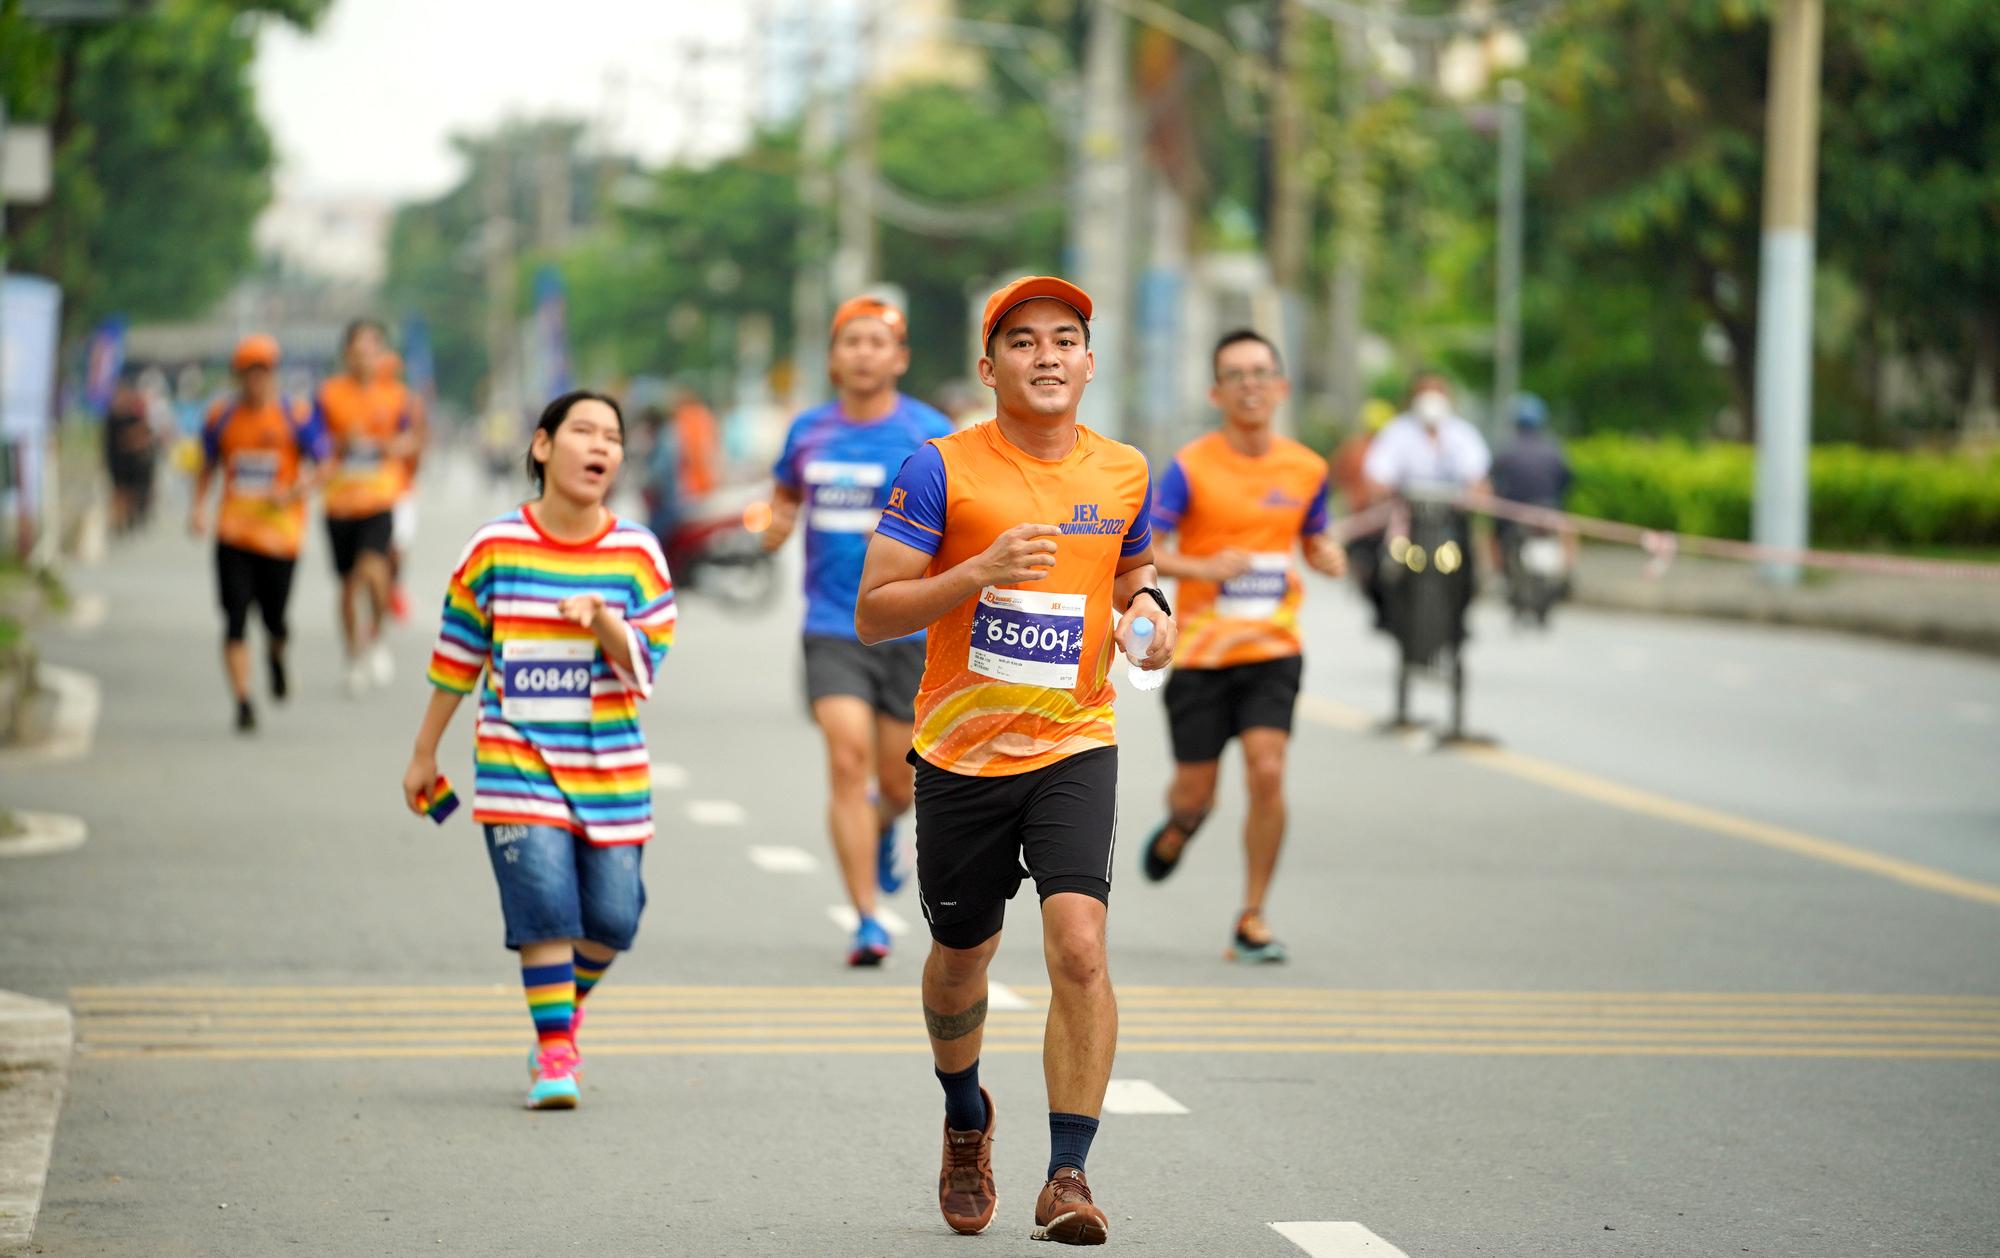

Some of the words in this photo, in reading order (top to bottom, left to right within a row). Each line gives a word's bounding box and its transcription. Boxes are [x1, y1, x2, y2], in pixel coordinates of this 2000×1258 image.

[1072, 503, 1099, 522] JEX
[1059, 522, 1098, 535] RUNNING
[1098, 518, 1125, 535] 2022
[1051, 602, 1062, 610] JEX
[987, 619, 1070, 652] 65001
[514, 667, 590, 692] 60849
